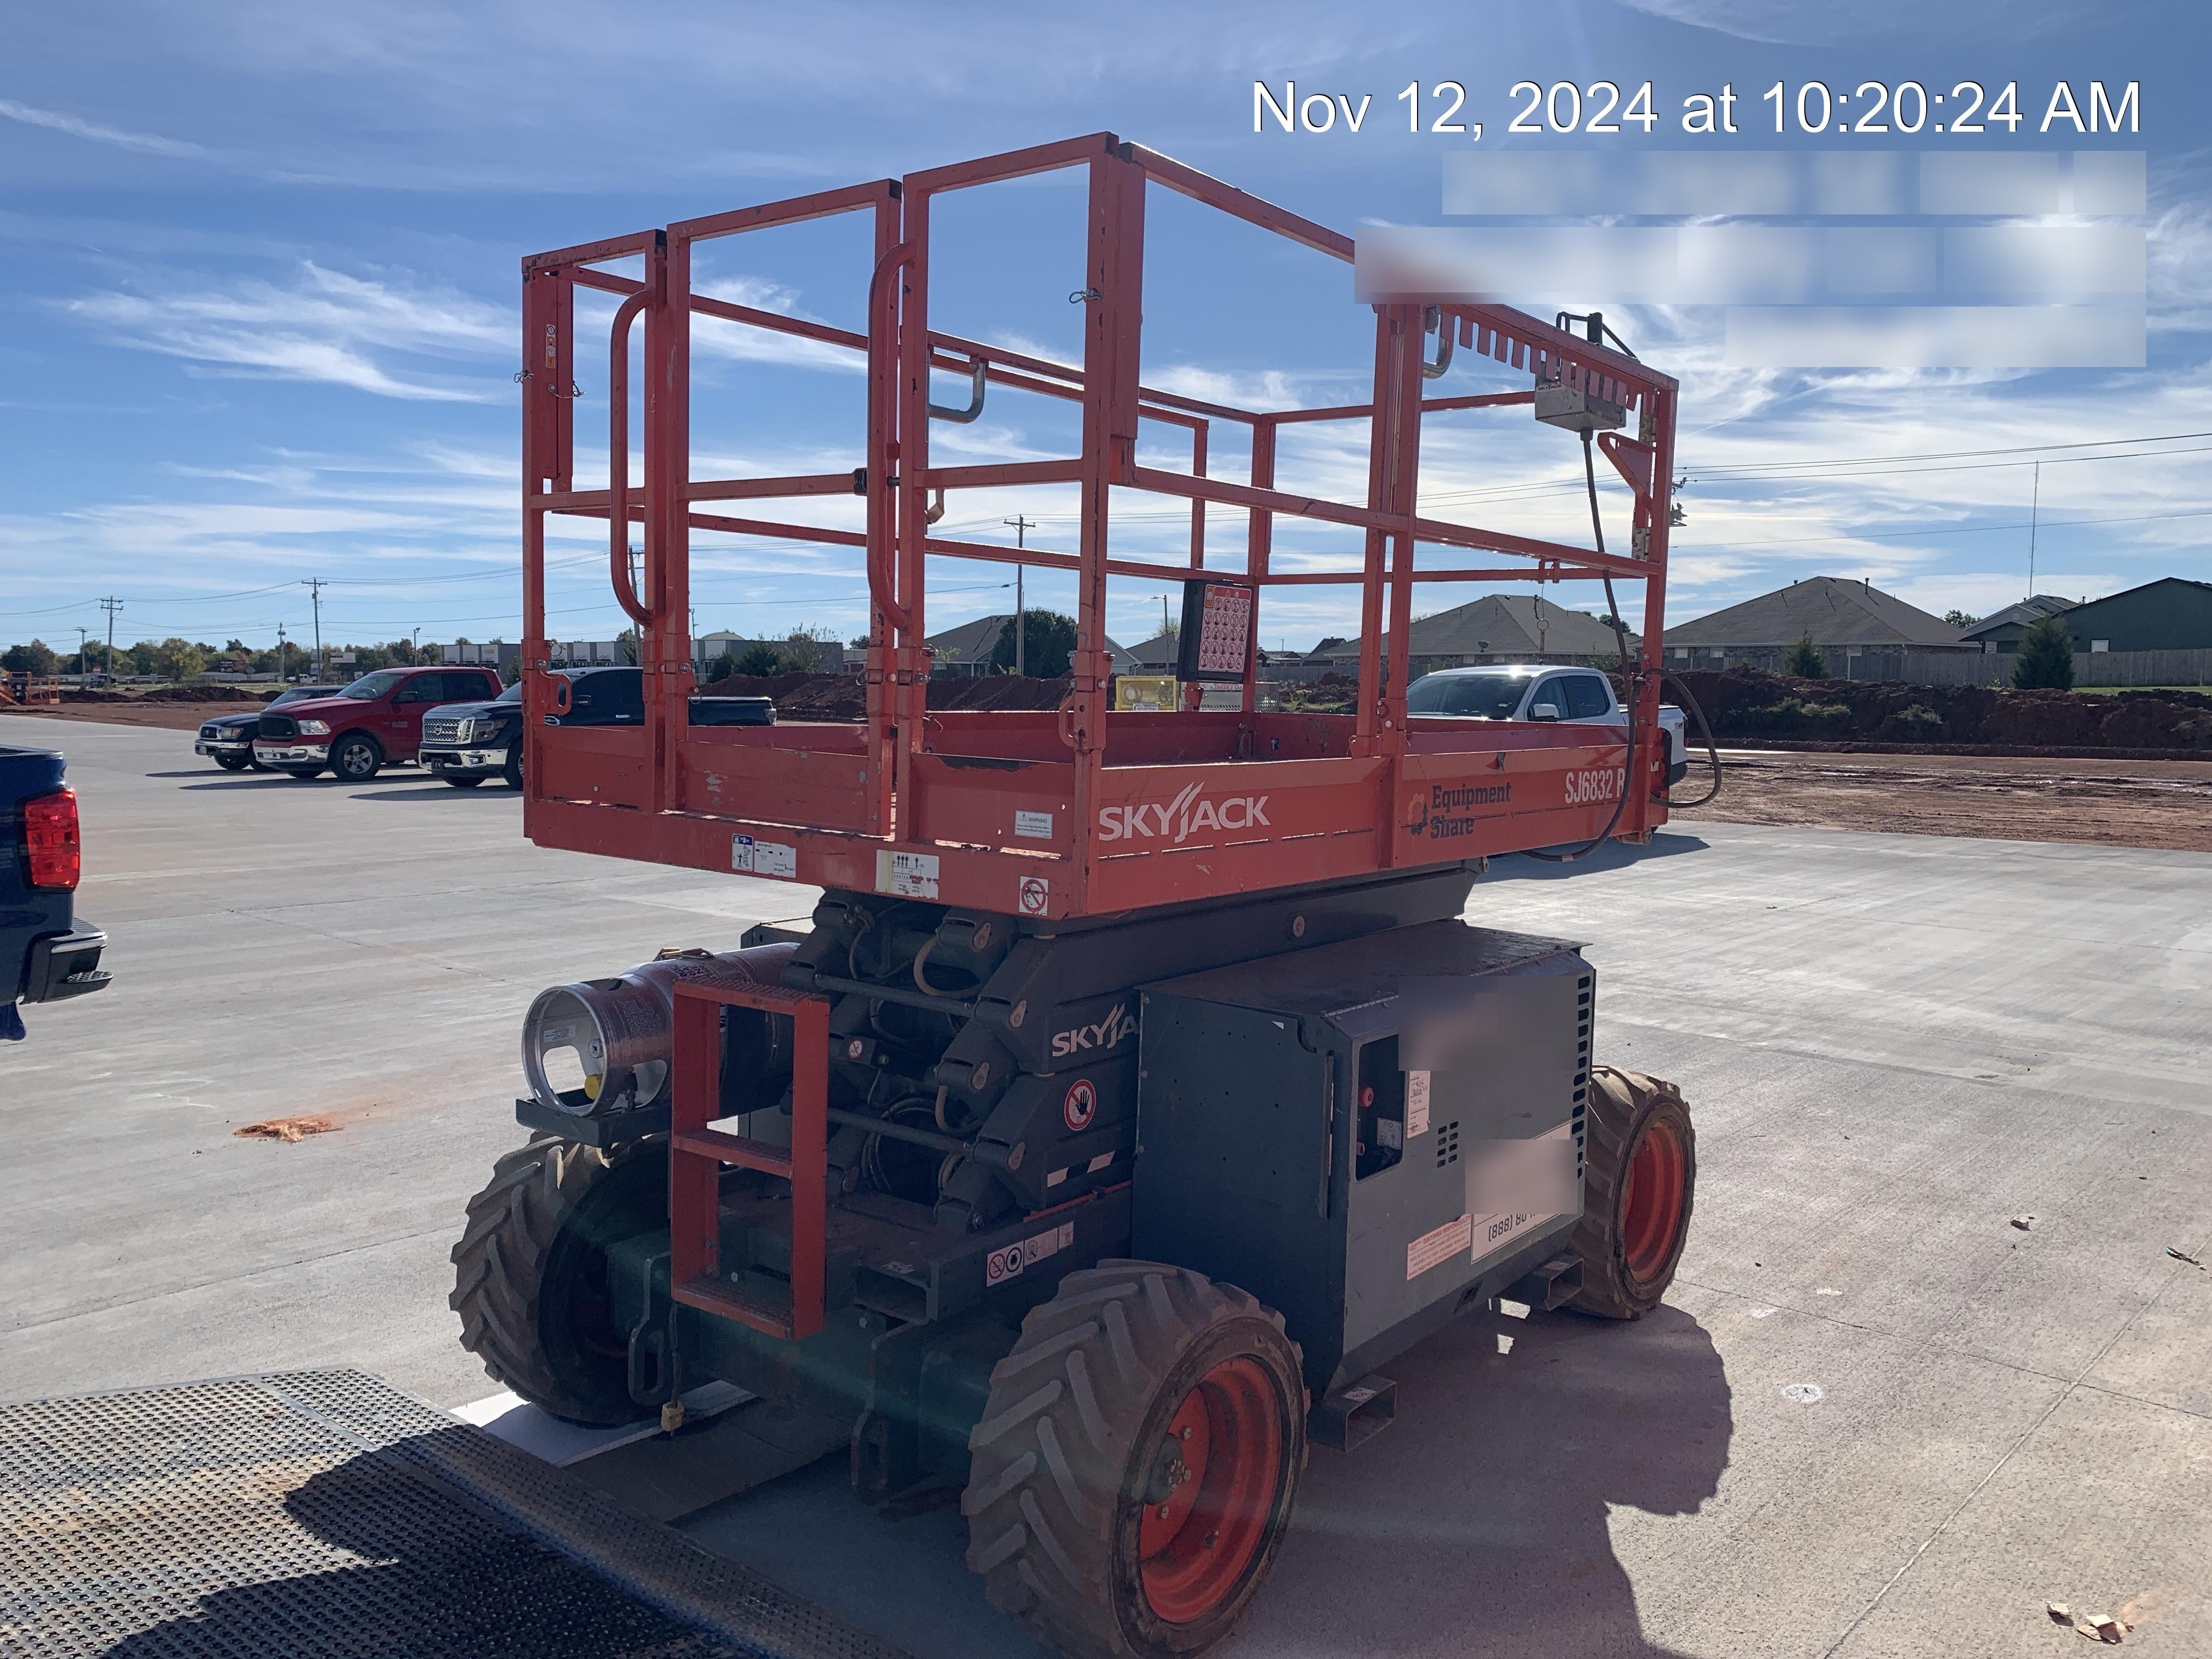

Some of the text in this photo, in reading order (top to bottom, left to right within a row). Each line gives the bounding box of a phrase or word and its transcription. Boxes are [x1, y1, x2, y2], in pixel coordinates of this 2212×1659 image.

[1431, 782, 1511, 813] Equipment
[1565, 769, 1613, 804] SJ6832
[1099, 781, 1271, 843] SKYJACK
[1430, 815, 1475, 839] Share
[1052, 1002, 1139, 1057] SKYJA
[1488, 1214, 1513, 1242] (888)
